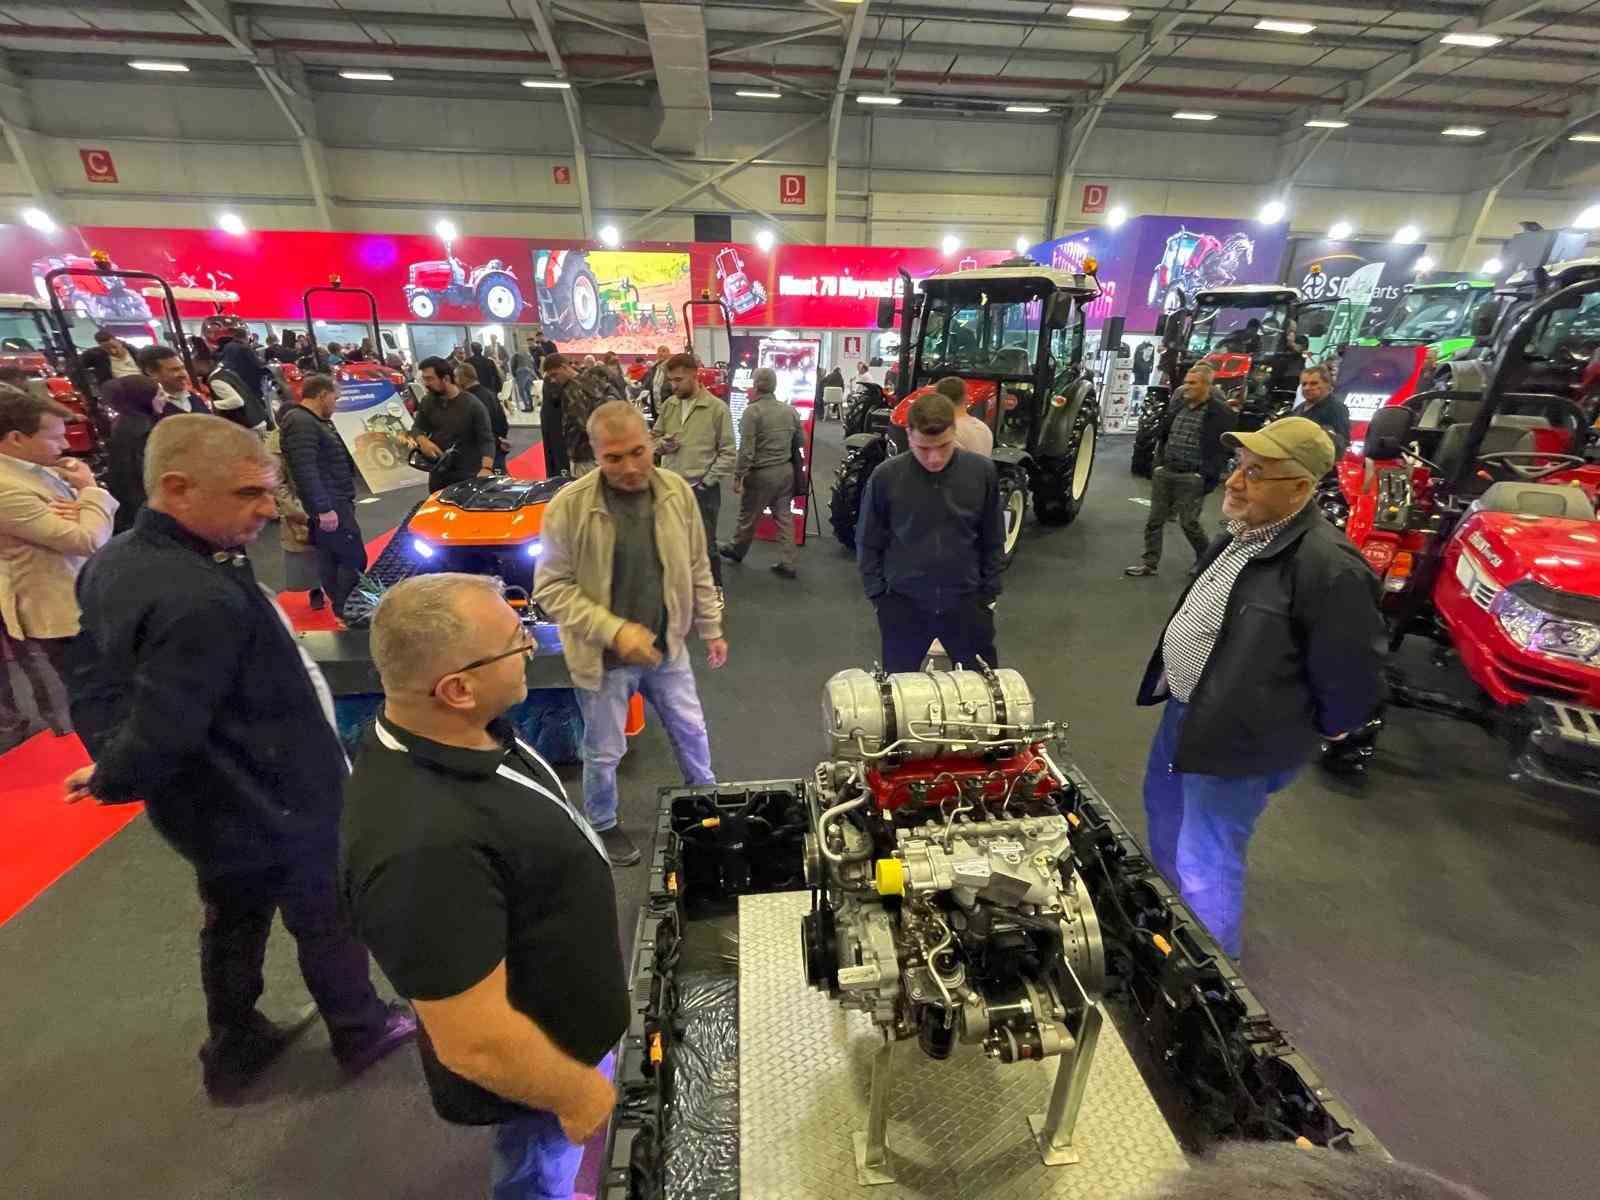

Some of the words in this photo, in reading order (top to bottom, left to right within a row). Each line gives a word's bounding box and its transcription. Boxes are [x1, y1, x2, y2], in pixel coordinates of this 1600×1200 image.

[88, 152, 108, 173] C
[786, 177, 800, 196] D
[1088, 187, 1102, 205] D
